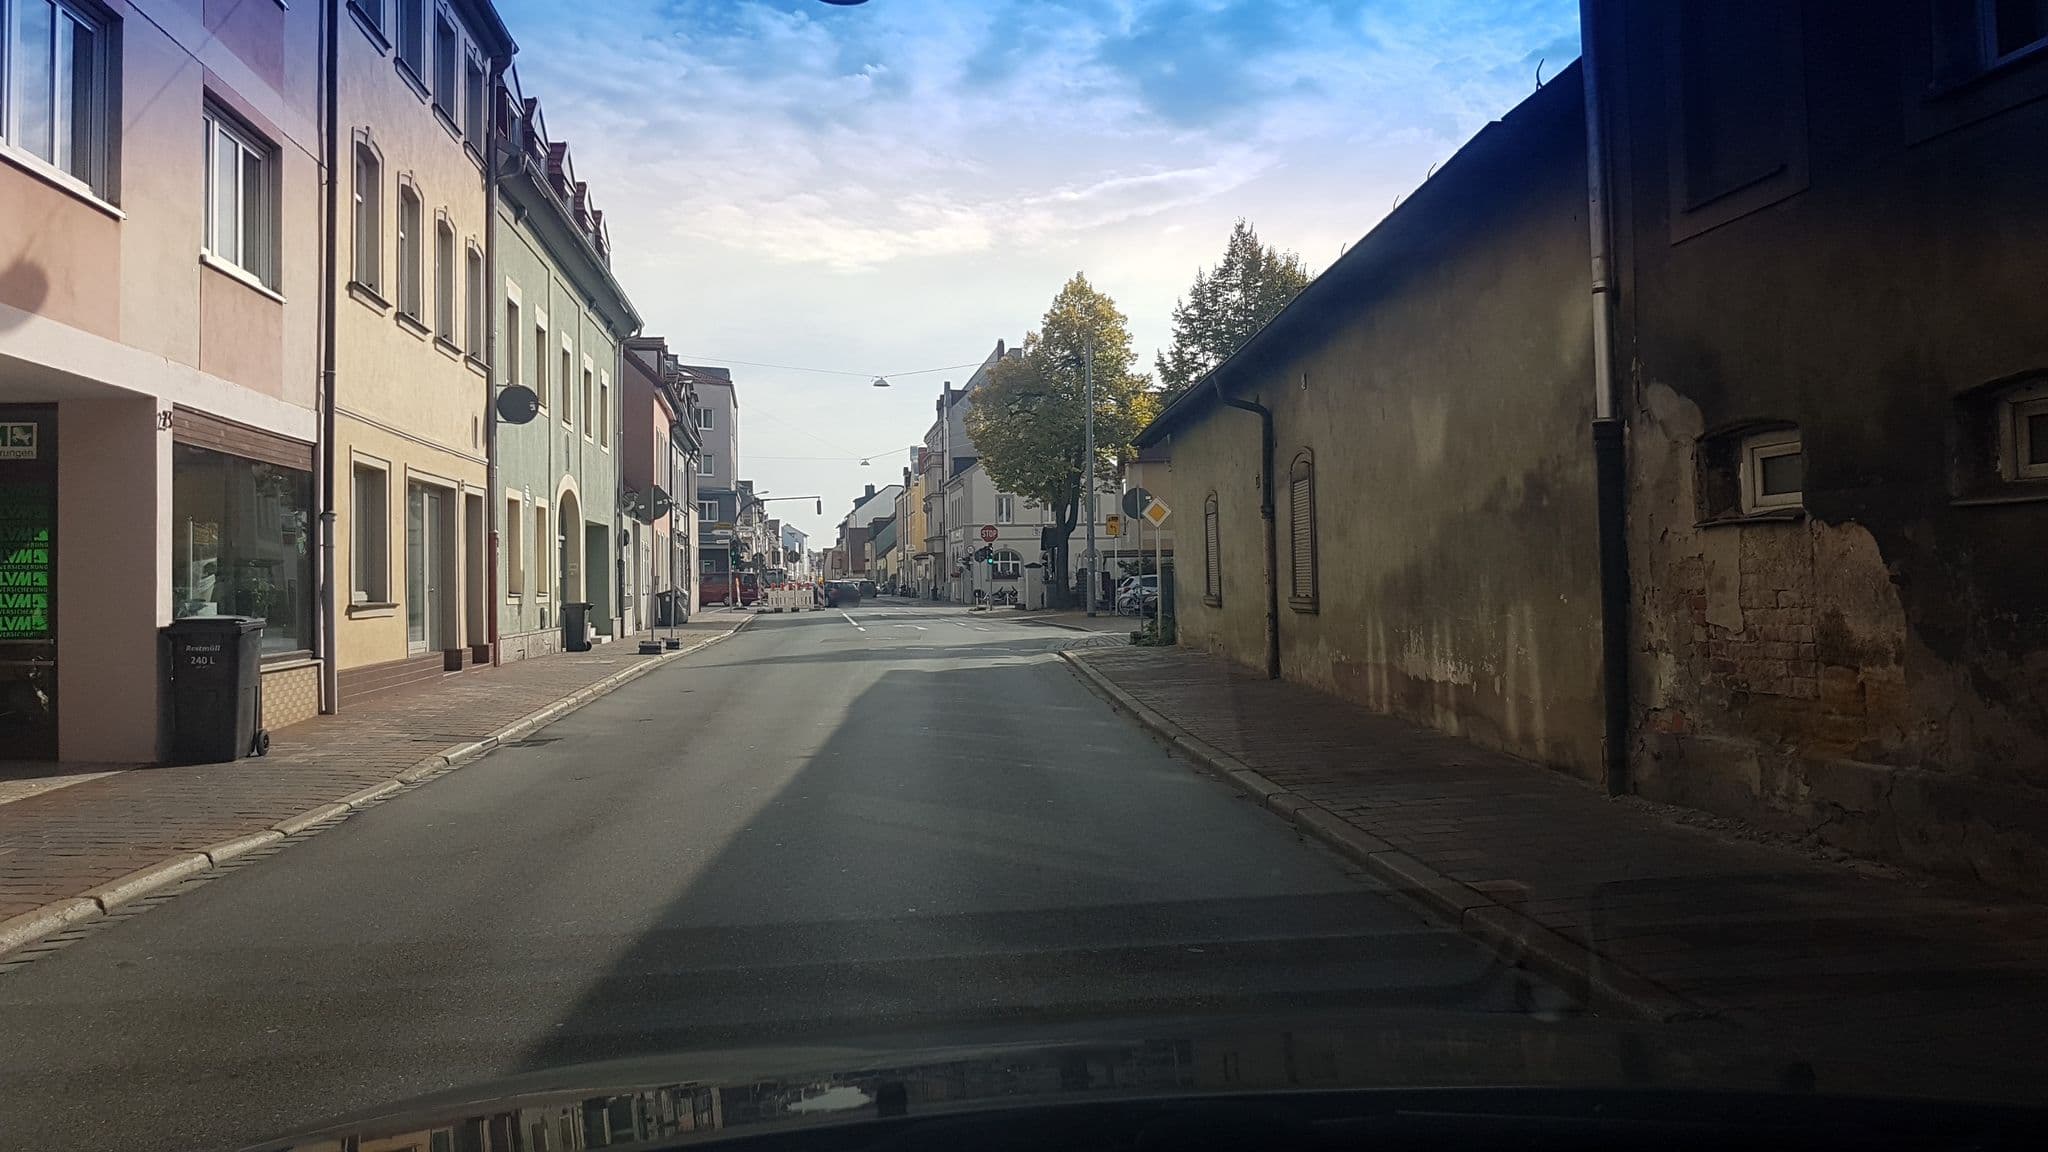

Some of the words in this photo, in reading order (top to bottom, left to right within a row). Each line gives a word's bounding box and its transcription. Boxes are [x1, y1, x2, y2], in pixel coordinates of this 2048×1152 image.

[981, 529, 997, 538] STOP
[0, 571, 32, 586] LVM
[0, 593, 32, 608] LVM
[0, 616, 32, 631] LVM
[190, 656, 208, 665] 240
[209, 656, 216, 665] L
